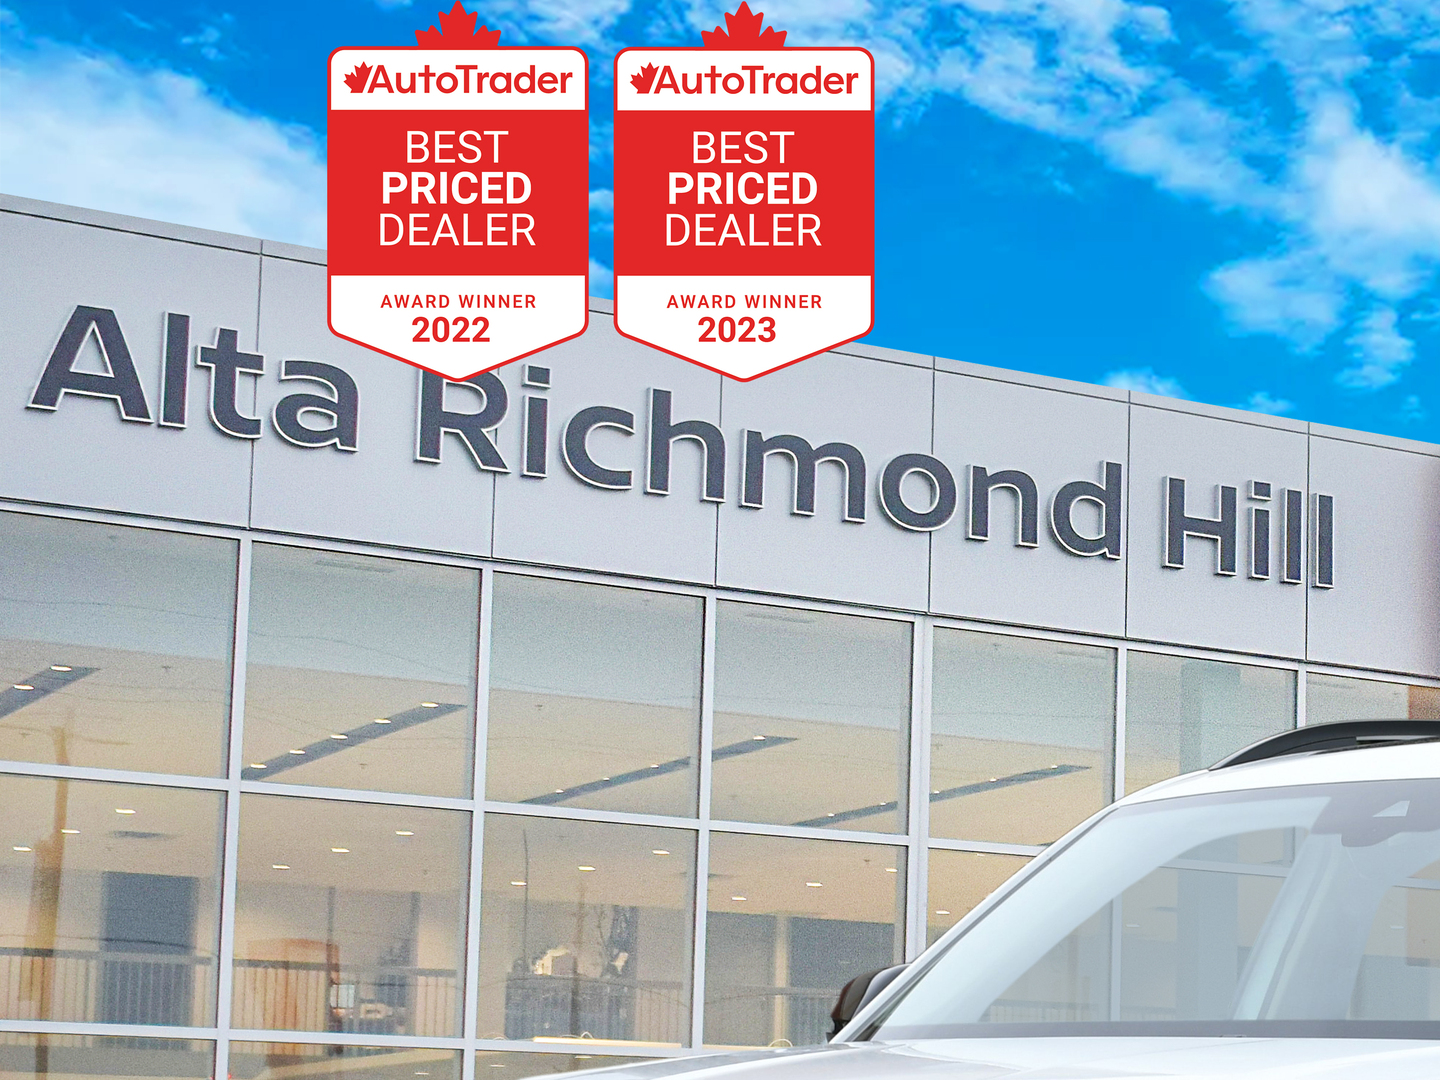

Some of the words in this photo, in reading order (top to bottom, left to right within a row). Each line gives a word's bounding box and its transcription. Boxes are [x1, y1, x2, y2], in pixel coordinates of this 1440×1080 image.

[26, 304, 359, 453] Alta
[413, 363, 1122, 560] Richmond
[1160, 475, 1334, 589] Hill
